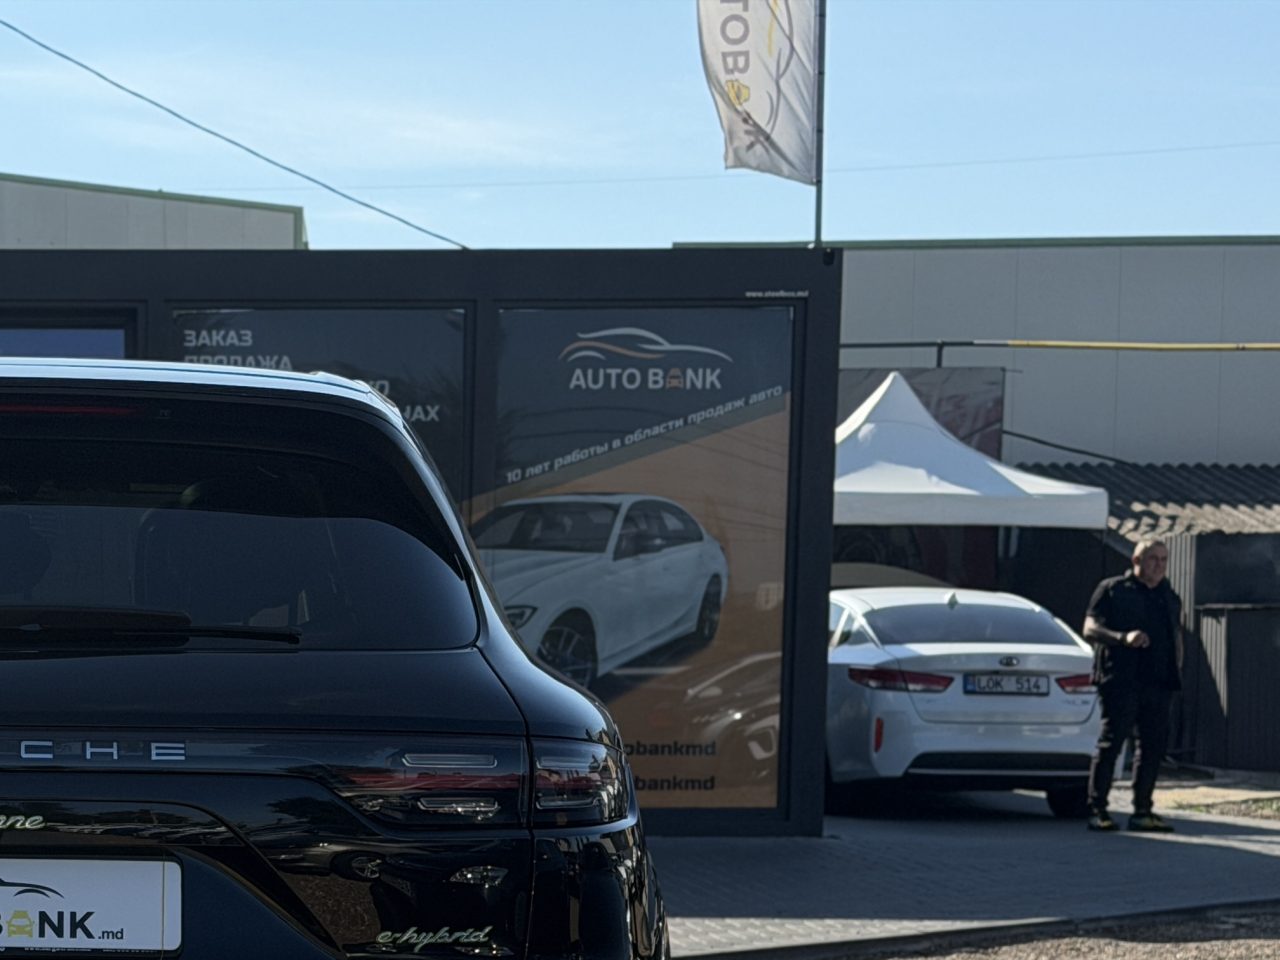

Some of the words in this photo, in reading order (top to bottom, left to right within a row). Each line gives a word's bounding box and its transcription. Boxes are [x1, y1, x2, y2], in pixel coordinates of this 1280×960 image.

[183, 329, 253, 347] ЗАКАЗ
[569, 367, 642, 390] AUTO
[505, 468, 523, 484] 10
[524, 460, 551, 479] лет
[553, 443, 609, 471] работы
[611, 439, 622, 450] в
[624, 418, 684, 445] области
[687, 398, 746, 425] продаж
[748, 385, 783, 405] авто
[1015, 678, 1041, 692] 514
[623, 740, 716, 756] obankmd
[634, 775, 716, 791] bankmd
